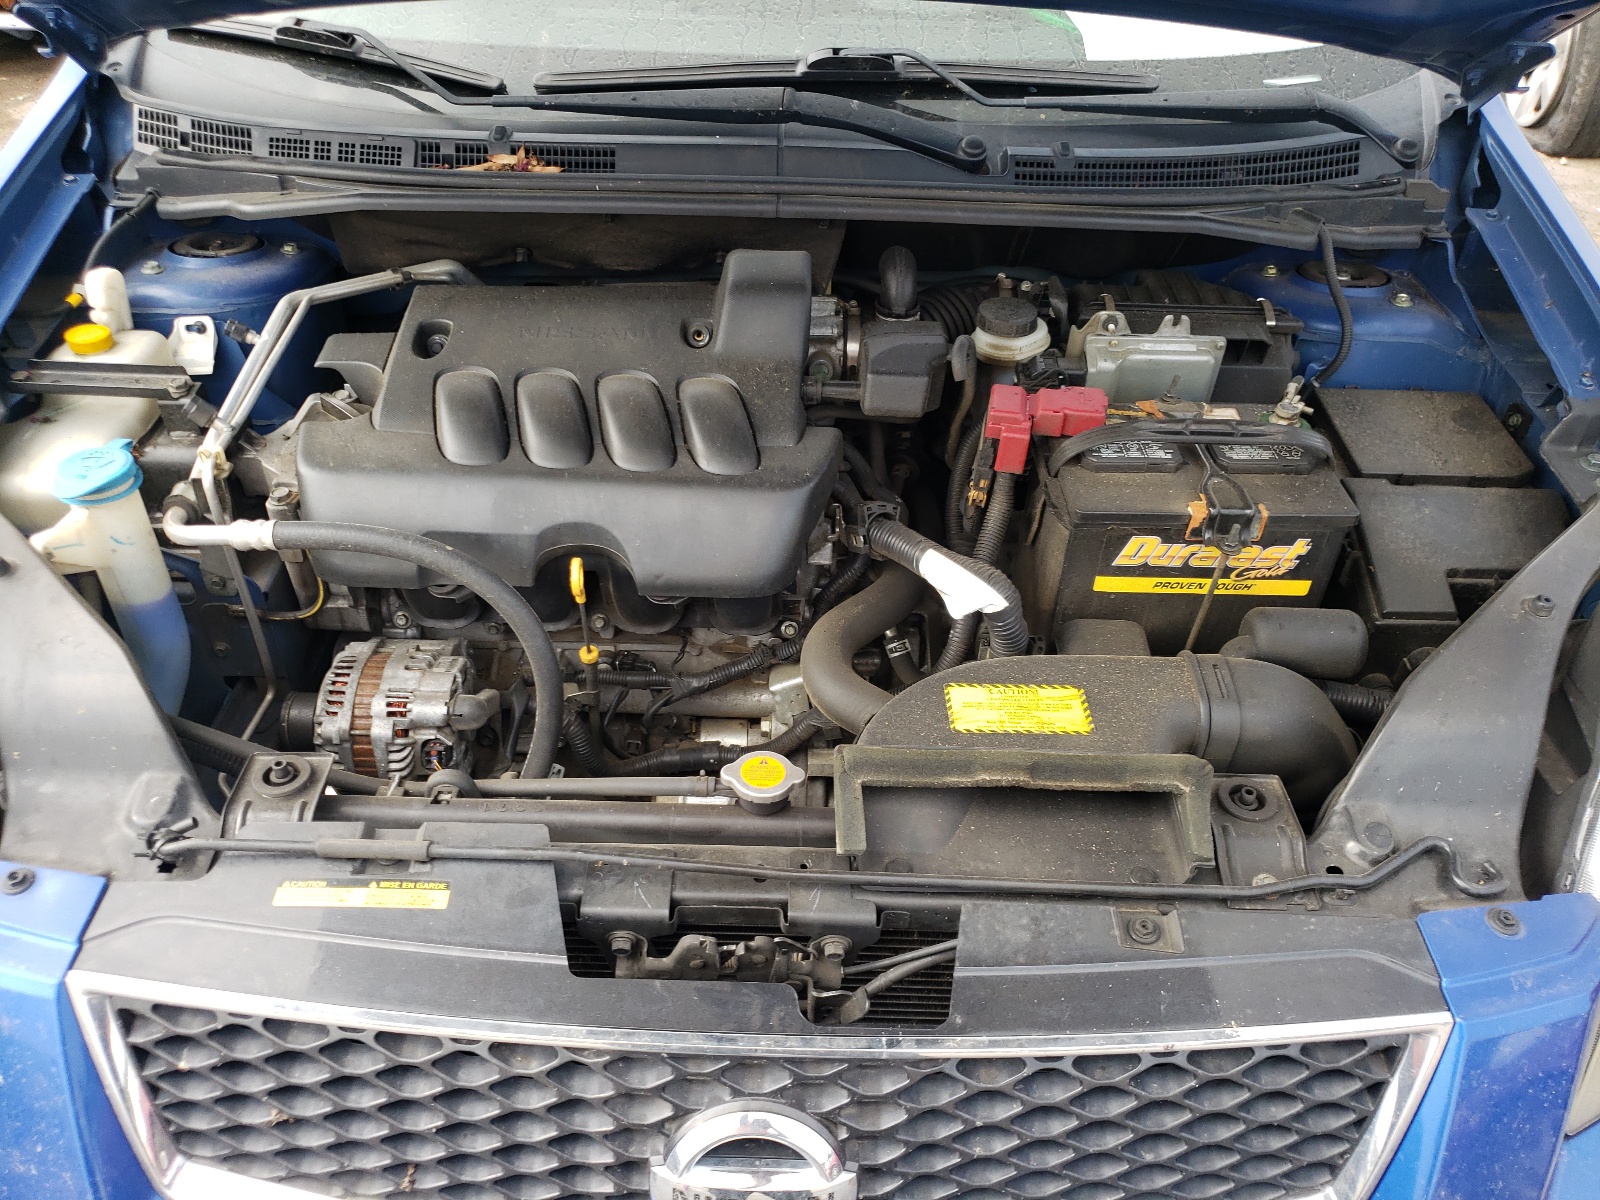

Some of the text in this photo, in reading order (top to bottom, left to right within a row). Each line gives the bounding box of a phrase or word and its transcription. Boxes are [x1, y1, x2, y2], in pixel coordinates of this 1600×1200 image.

[517, 325, 647, 341] NISSAN
[1111, 535, 1312, 569] Duraast
[1230, 565, 1290, 581] Gold
[1152, 581, 1253, 591] PROVEN OUGH
[379, 881, 401, 889] MISE
[416, 882, 448, 890] GARDE
